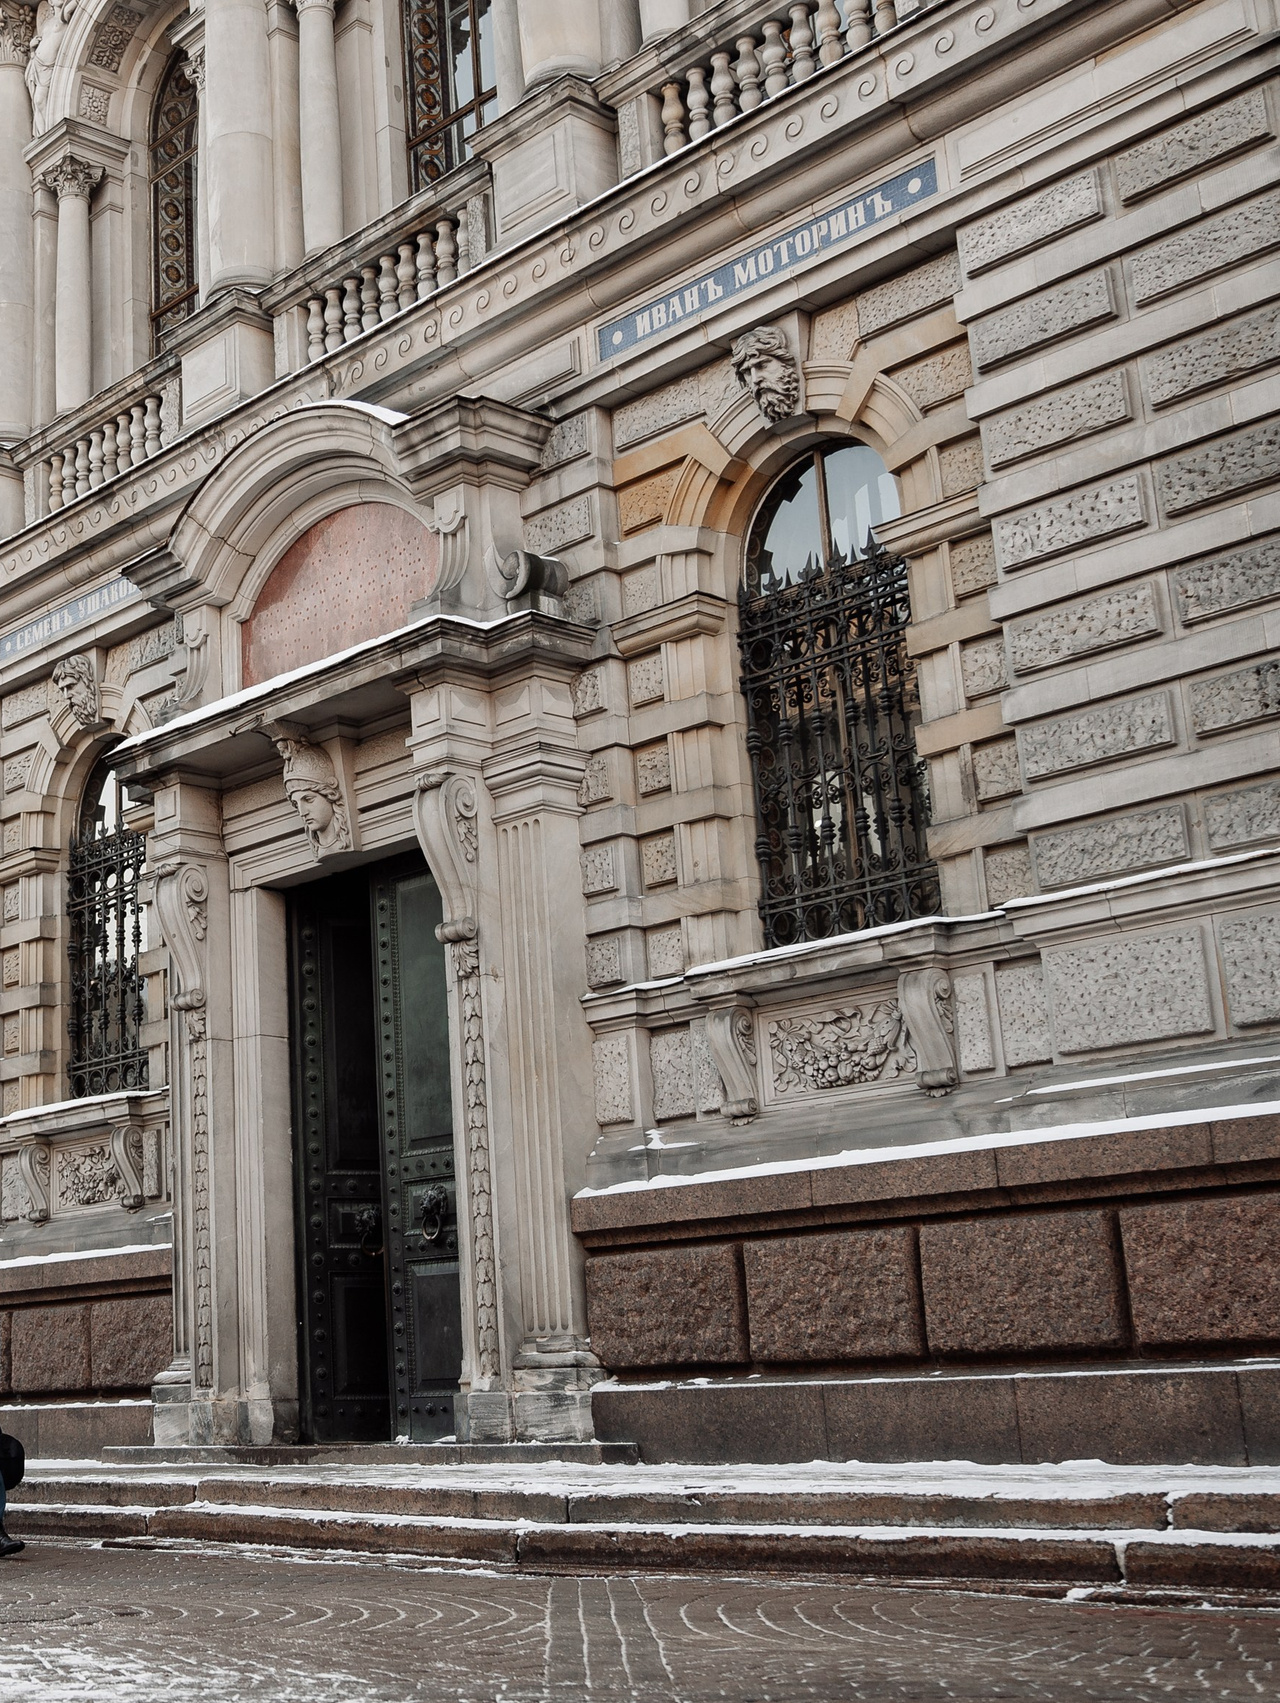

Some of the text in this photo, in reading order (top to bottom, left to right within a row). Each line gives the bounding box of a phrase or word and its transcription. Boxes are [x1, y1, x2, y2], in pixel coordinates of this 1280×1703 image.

[635, 192, 892, 339] ИВАНЪ МОТОРИНЪ
[16, 608, 73, 651] СЕМЕНЪ
